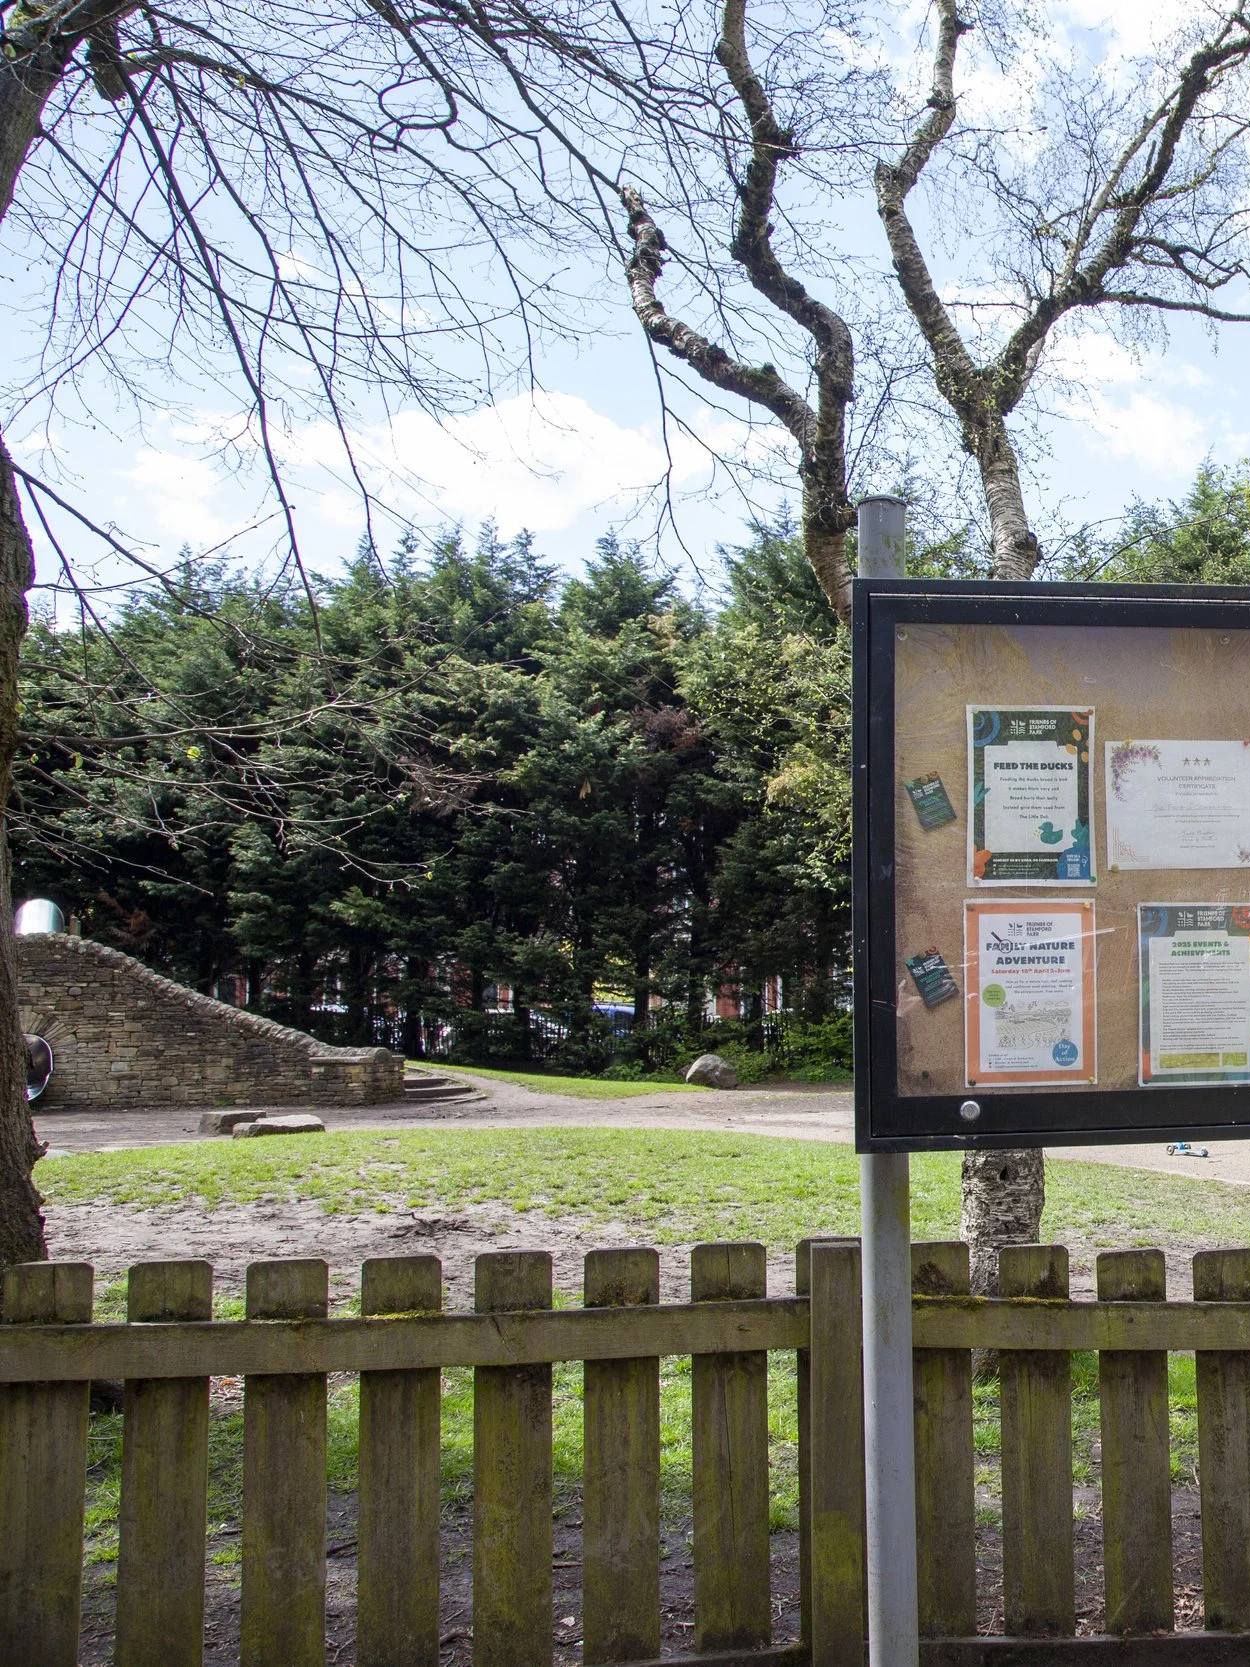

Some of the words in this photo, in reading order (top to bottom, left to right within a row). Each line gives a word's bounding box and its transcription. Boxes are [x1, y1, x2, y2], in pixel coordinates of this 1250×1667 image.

[986, 942, 1027, 950] FAMILY
[1030, 942, 1075, 950] NATURE
[996, 956, 1065, 965] ADVENTURE
